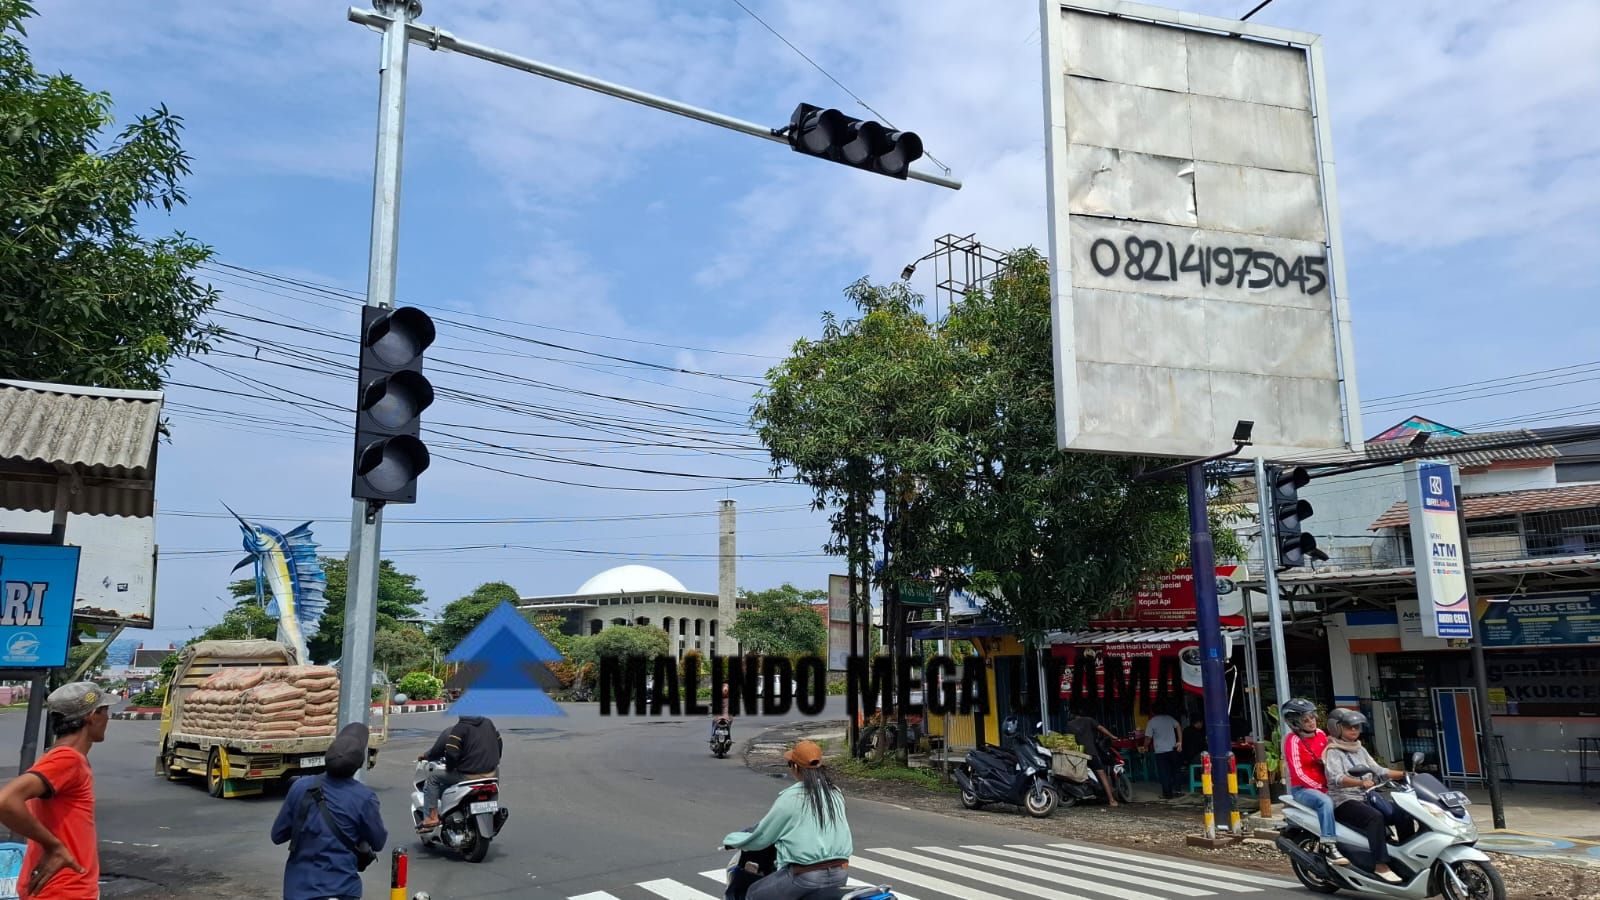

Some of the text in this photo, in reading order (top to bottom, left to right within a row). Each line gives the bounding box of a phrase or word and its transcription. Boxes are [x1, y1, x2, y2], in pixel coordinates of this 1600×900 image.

[1090, 236, 1326, 295] 082141975045
[1433, 543, 1457, 557] ATM
[0, 580, 48, 626] RI
[1138, 597, 1171, 607] Kapal Api
[1507, 605, 1552, 613] AKUR
[1555, 602, 1597, 611] CELL
[1403, 611, 1420, 619] Age
[1453, 613, 1468, 624] CELL
[1142, 642, 1170, 651] Dengan
[1503, 683, 1600, 698] AKURCE
